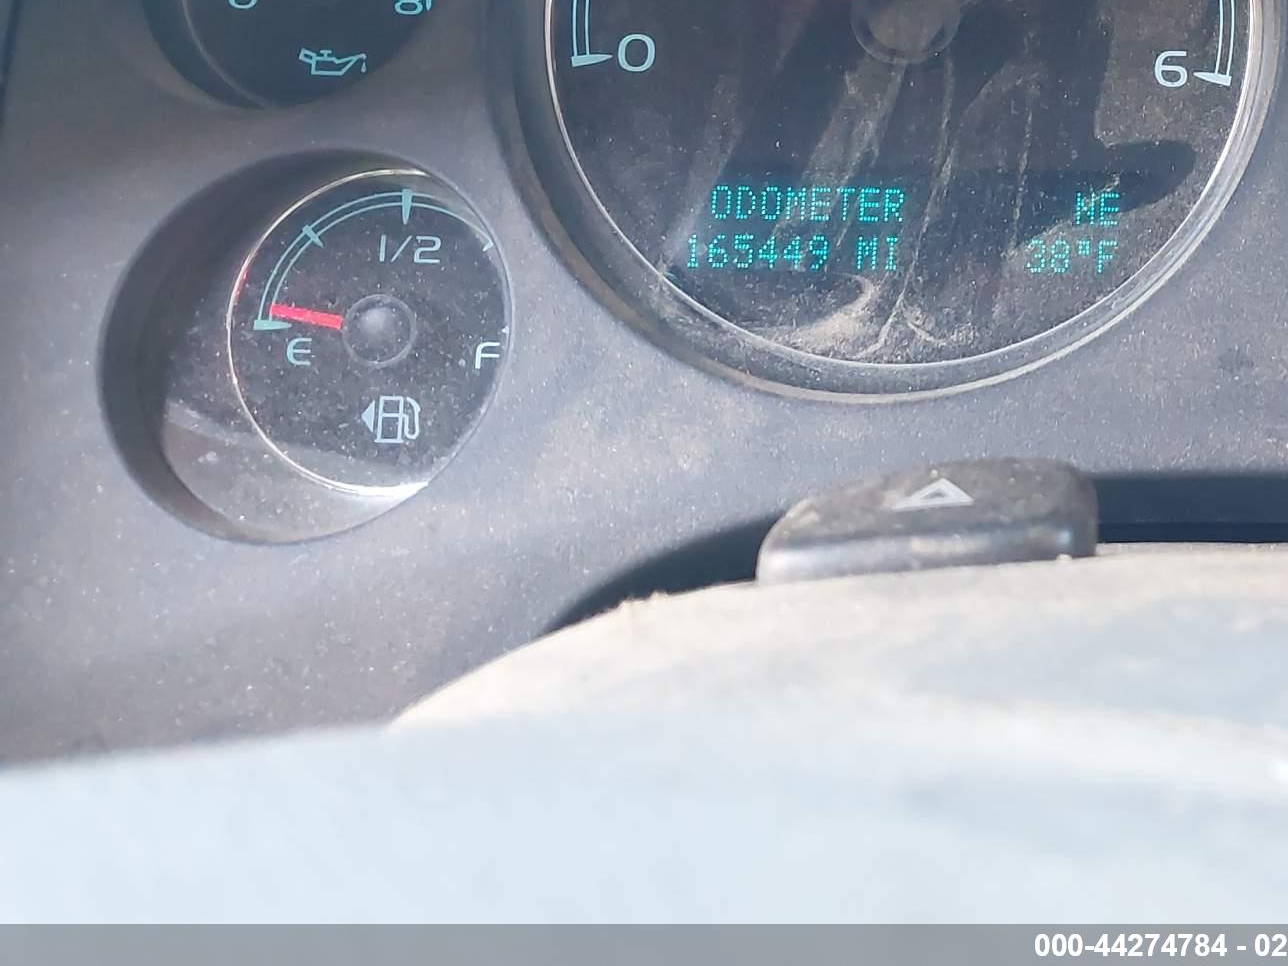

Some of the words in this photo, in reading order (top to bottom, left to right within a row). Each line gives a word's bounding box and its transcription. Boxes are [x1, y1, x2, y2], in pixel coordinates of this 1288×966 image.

[616, 33, 657, 71] 0
[1152, 50, 1187, 87] 6
[711, 185, 905, 222] ODOMETER
[1075, 191, 1120, 227] NE
[379, 234, 441, 264] 1/2
[686, 234, 831, 271] 165449
[856, 236, 898, 271] MI
[286, 337, 312, 366] E
[474, 341, 500, 370] F
